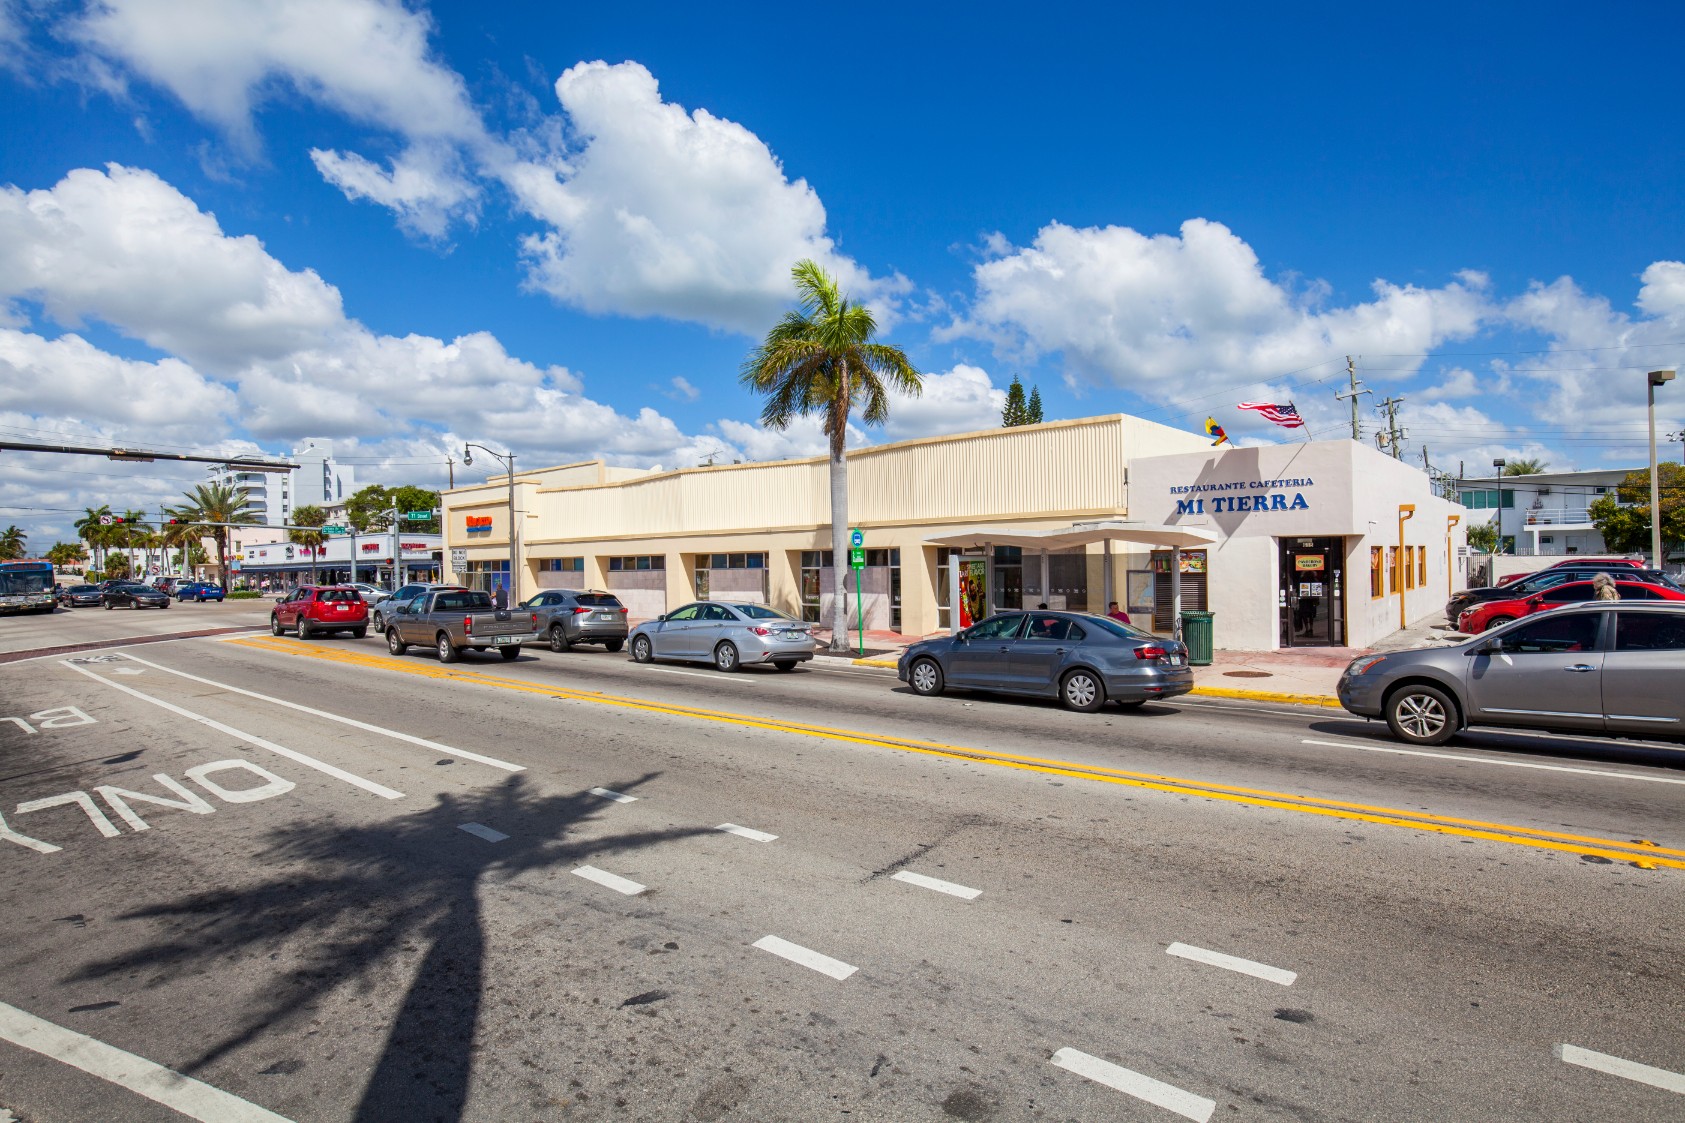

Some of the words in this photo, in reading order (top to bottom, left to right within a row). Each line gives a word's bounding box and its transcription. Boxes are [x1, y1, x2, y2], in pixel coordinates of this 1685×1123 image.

[1170, 482, 1246, 494] RESTAURANTE
[1249, 477, 1314, 489] CAFETERIA
[1176, 498, 1205, 516] MI
[1211, 492, 1310, 513] TIERRA
